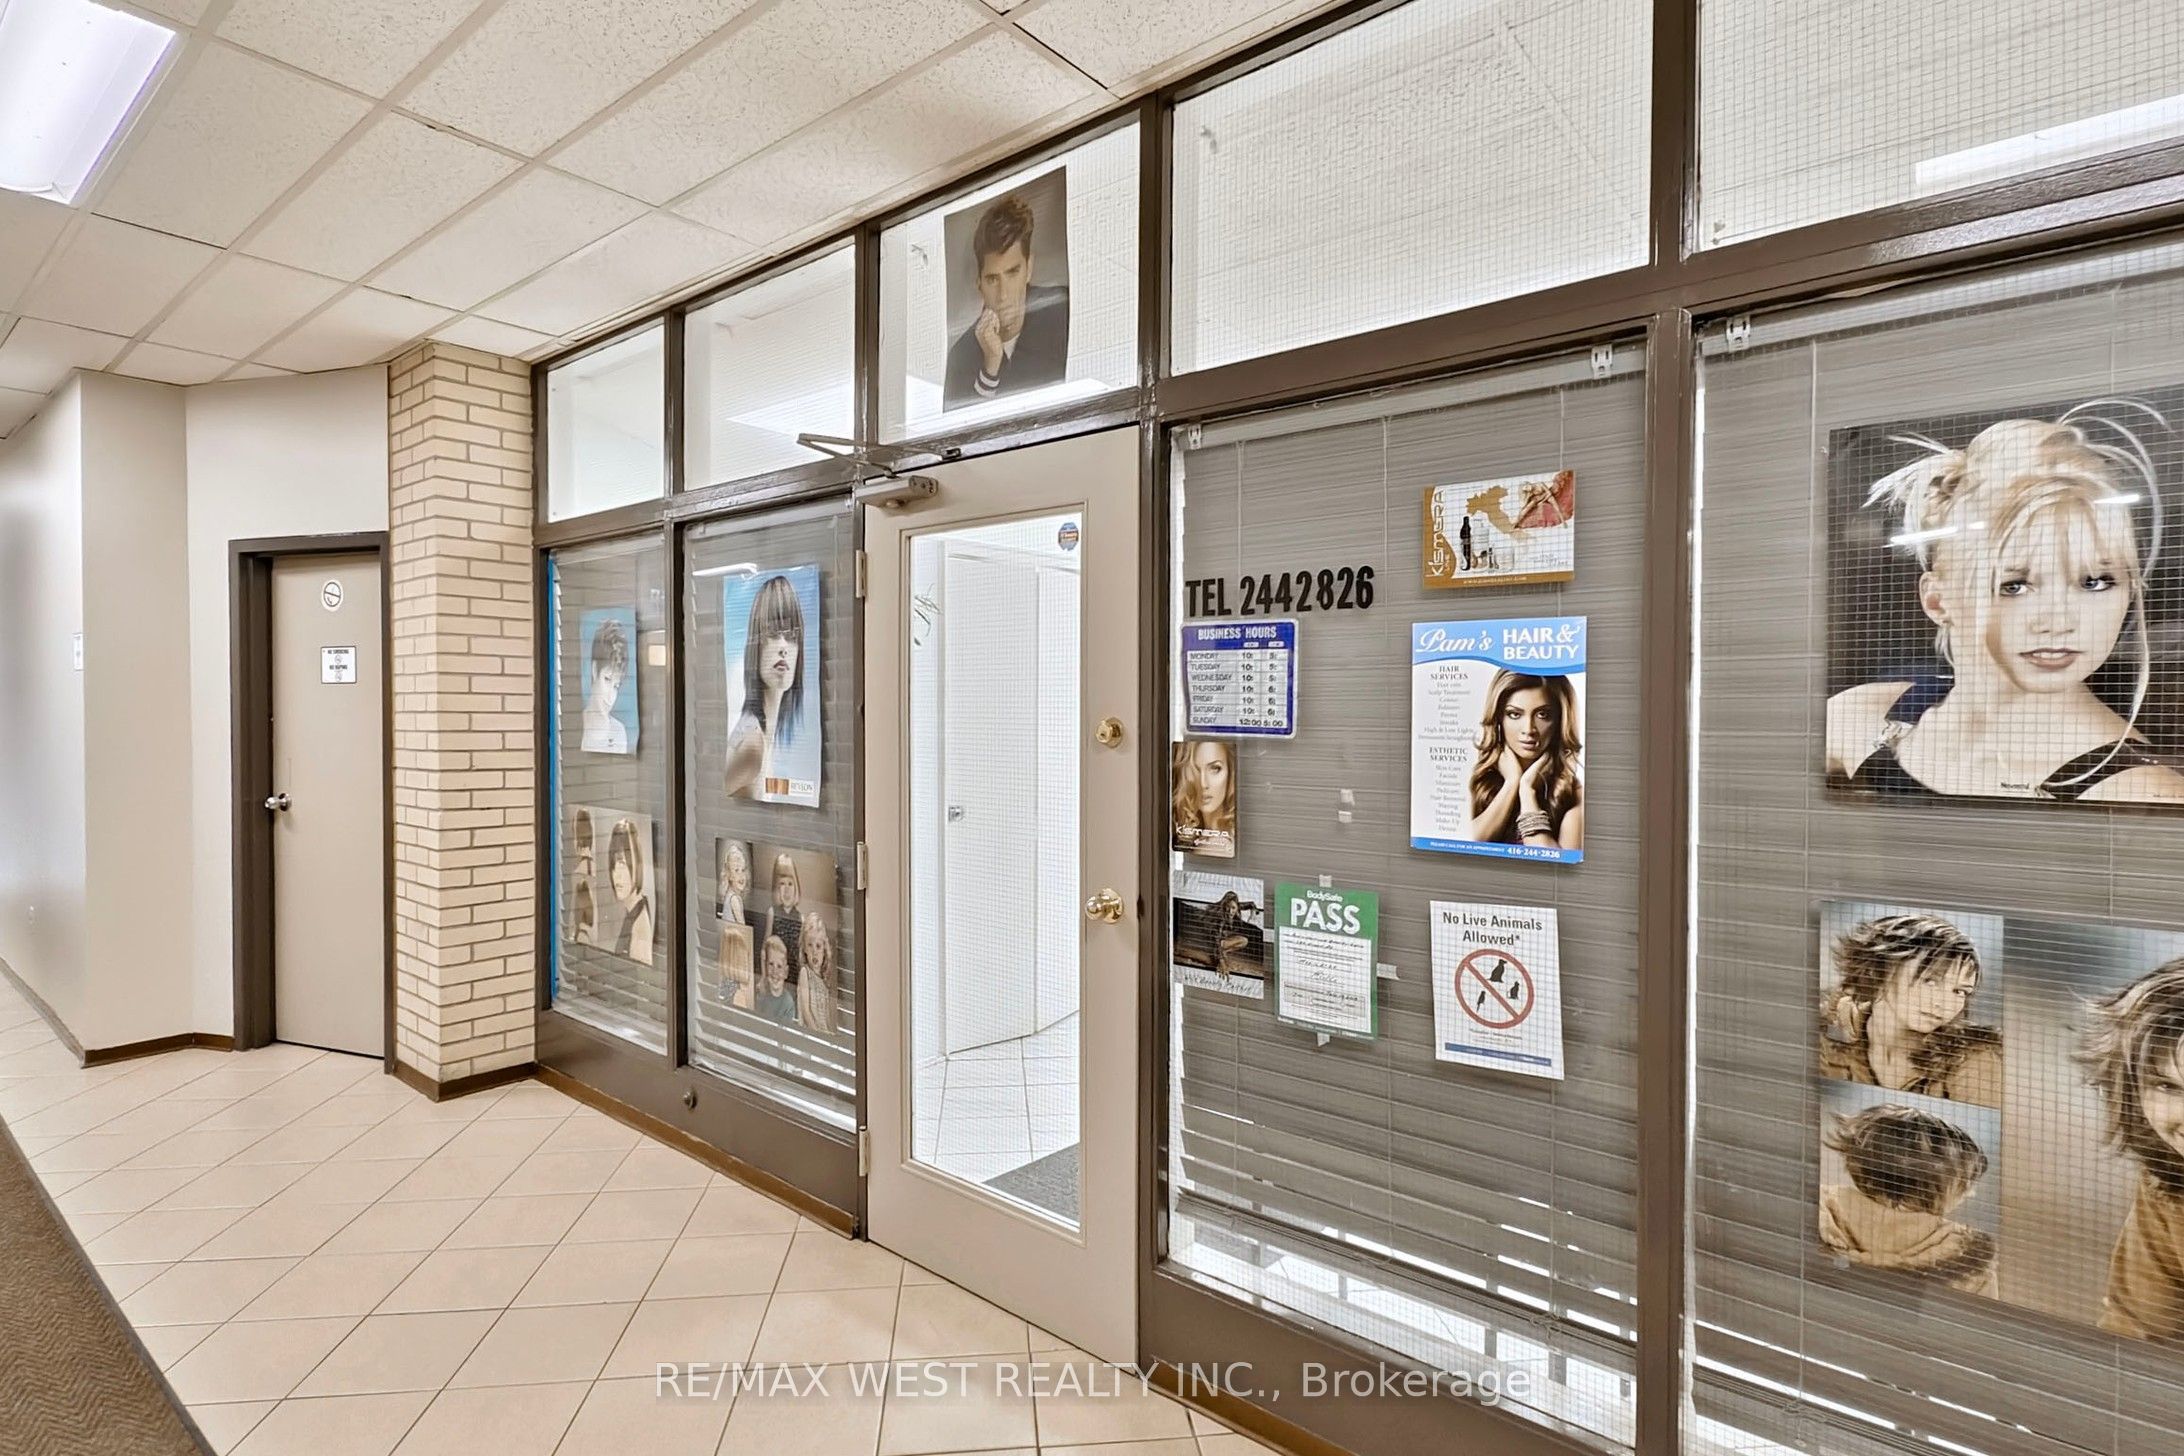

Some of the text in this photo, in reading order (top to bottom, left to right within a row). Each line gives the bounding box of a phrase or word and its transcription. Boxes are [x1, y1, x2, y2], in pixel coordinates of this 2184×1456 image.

[1185, 565, 1375, 617] TEL 2442826
[1198, 626, 1277, 640] BUSINESS HOURS
[1415, 628, 1494, 653] Pam's
[1503, 627, 1554, 645] HAIR
[1503, 645, 1579, 661] BEAUTY
[1306, 890, 1343, 902] BodySafe
[1290, 897, 1361, 935] PASS
[1443, 911, 1543, 931] No Live Animals
